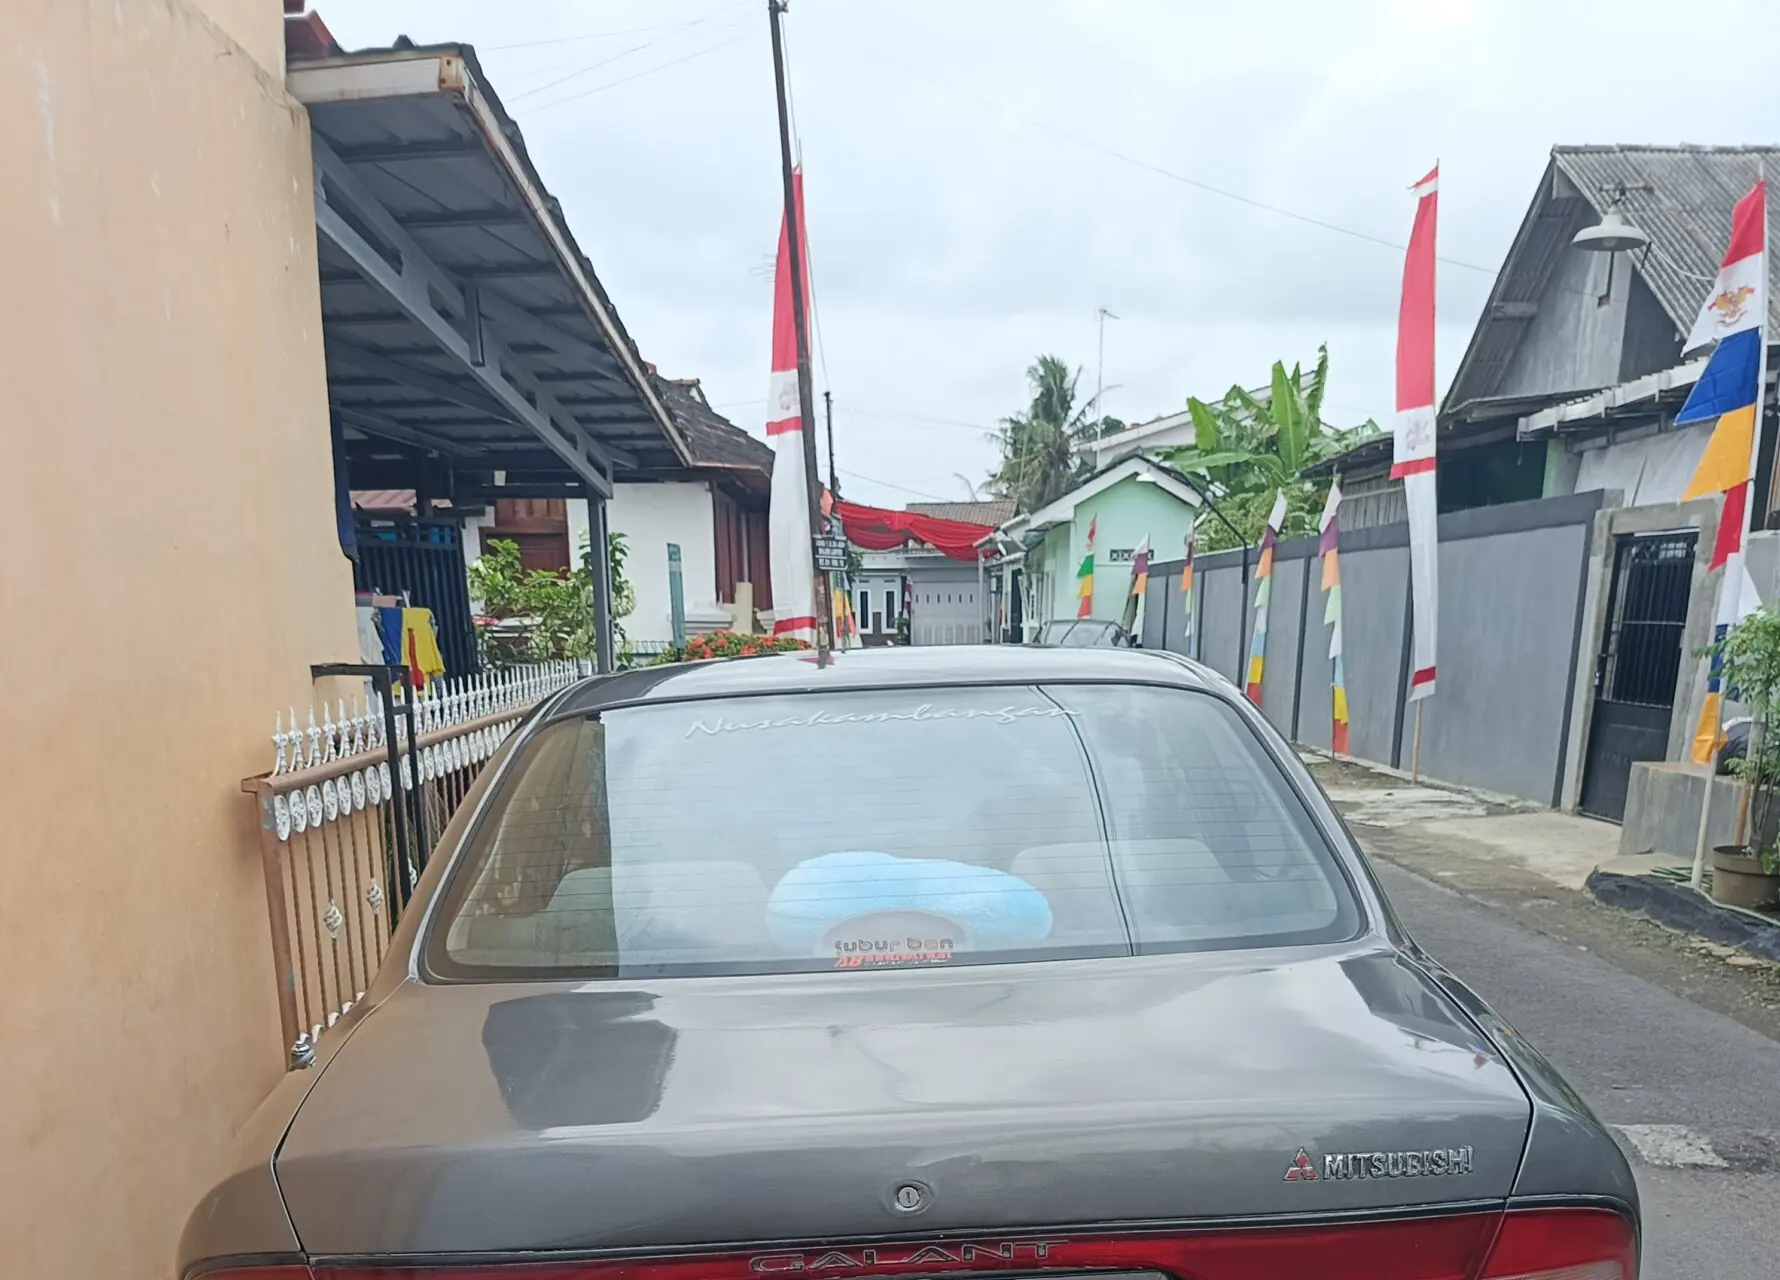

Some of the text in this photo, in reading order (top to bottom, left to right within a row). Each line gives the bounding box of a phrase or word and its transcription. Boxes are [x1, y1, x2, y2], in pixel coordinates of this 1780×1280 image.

[683, 703, 1082, 740] Nusakambangan
[1323, 1145, 1474, 1180] MITSUBISHI
[748, 1239, 1069, 1273] GALANT
